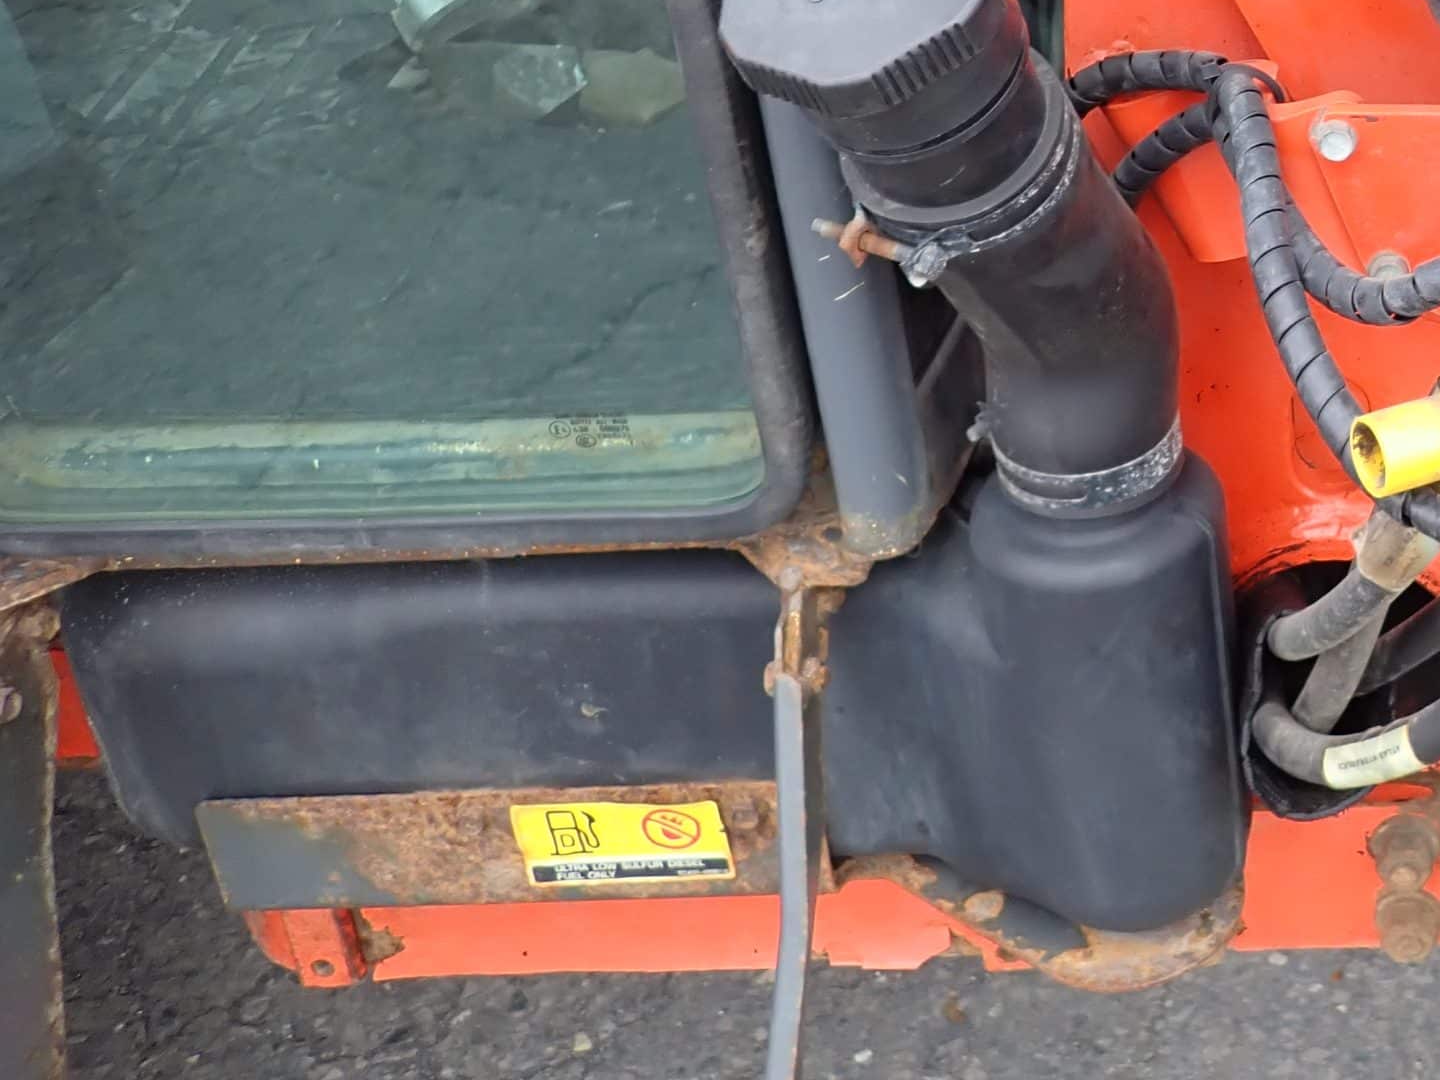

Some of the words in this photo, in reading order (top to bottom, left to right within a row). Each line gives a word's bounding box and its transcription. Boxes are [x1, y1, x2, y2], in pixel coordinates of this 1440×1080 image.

[591, 862, 618, 871] LOW
[555, 871, 585, 881] FUEL
[586, 870, 617, 880] ONLY
